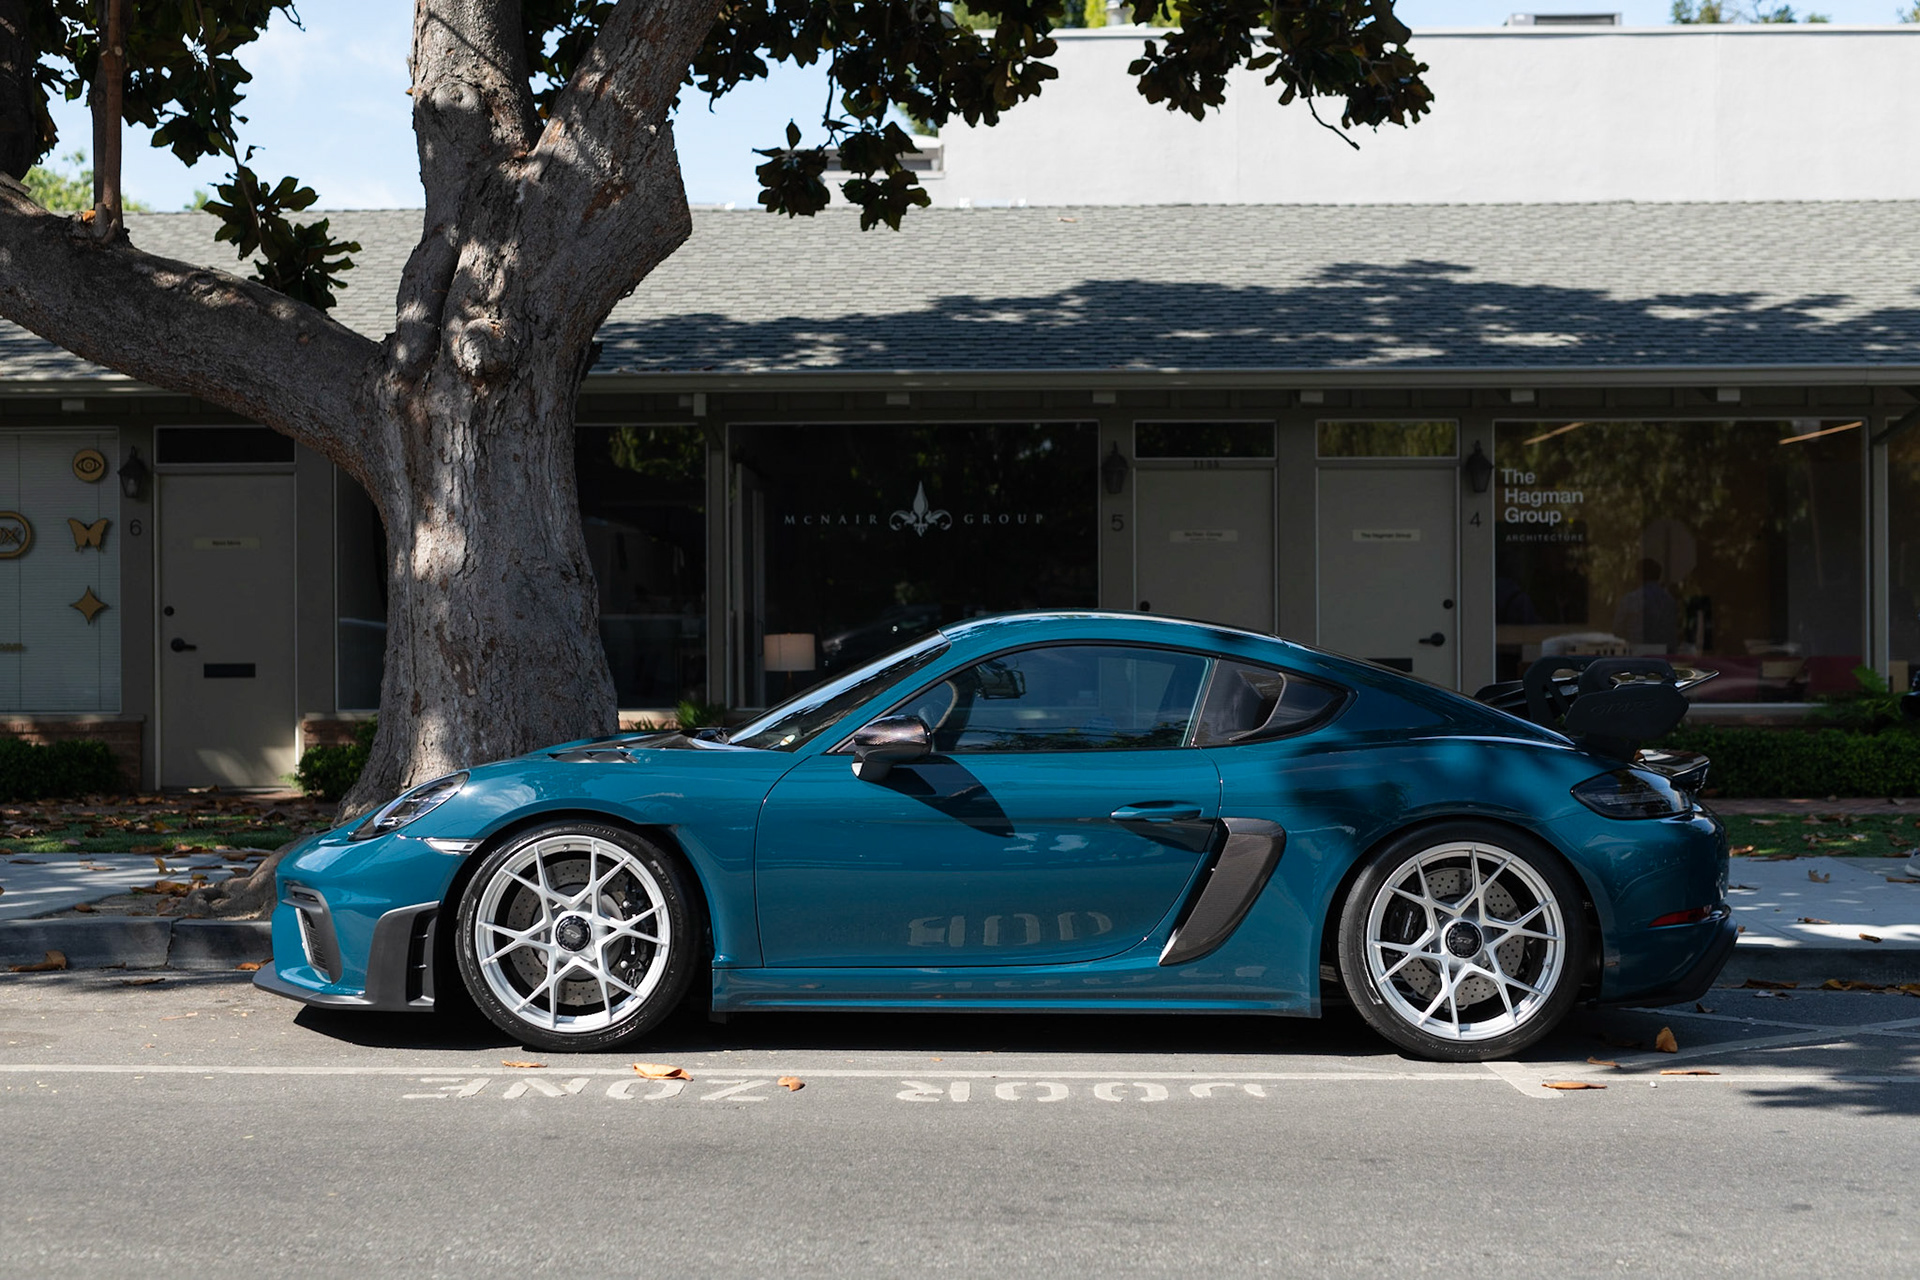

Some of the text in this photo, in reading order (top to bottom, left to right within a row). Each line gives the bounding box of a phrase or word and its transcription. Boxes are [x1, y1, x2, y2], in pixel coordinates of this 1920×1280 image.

[1500, 468, 1536, 484] The
[1504, 487, 1584, 507] Hagman
[963, 513, 1045, 525] GROUP
[1111, 514, 1124, 532] 5
[1469, 512, 1481, 527] 4
[1504, 507, 1562, 526] Group
[129, 518, 142, 536] 6
[1505, 533, 1584, 543] ARCHITECTURE
[402, 1078, 769, 1101] ZONE
